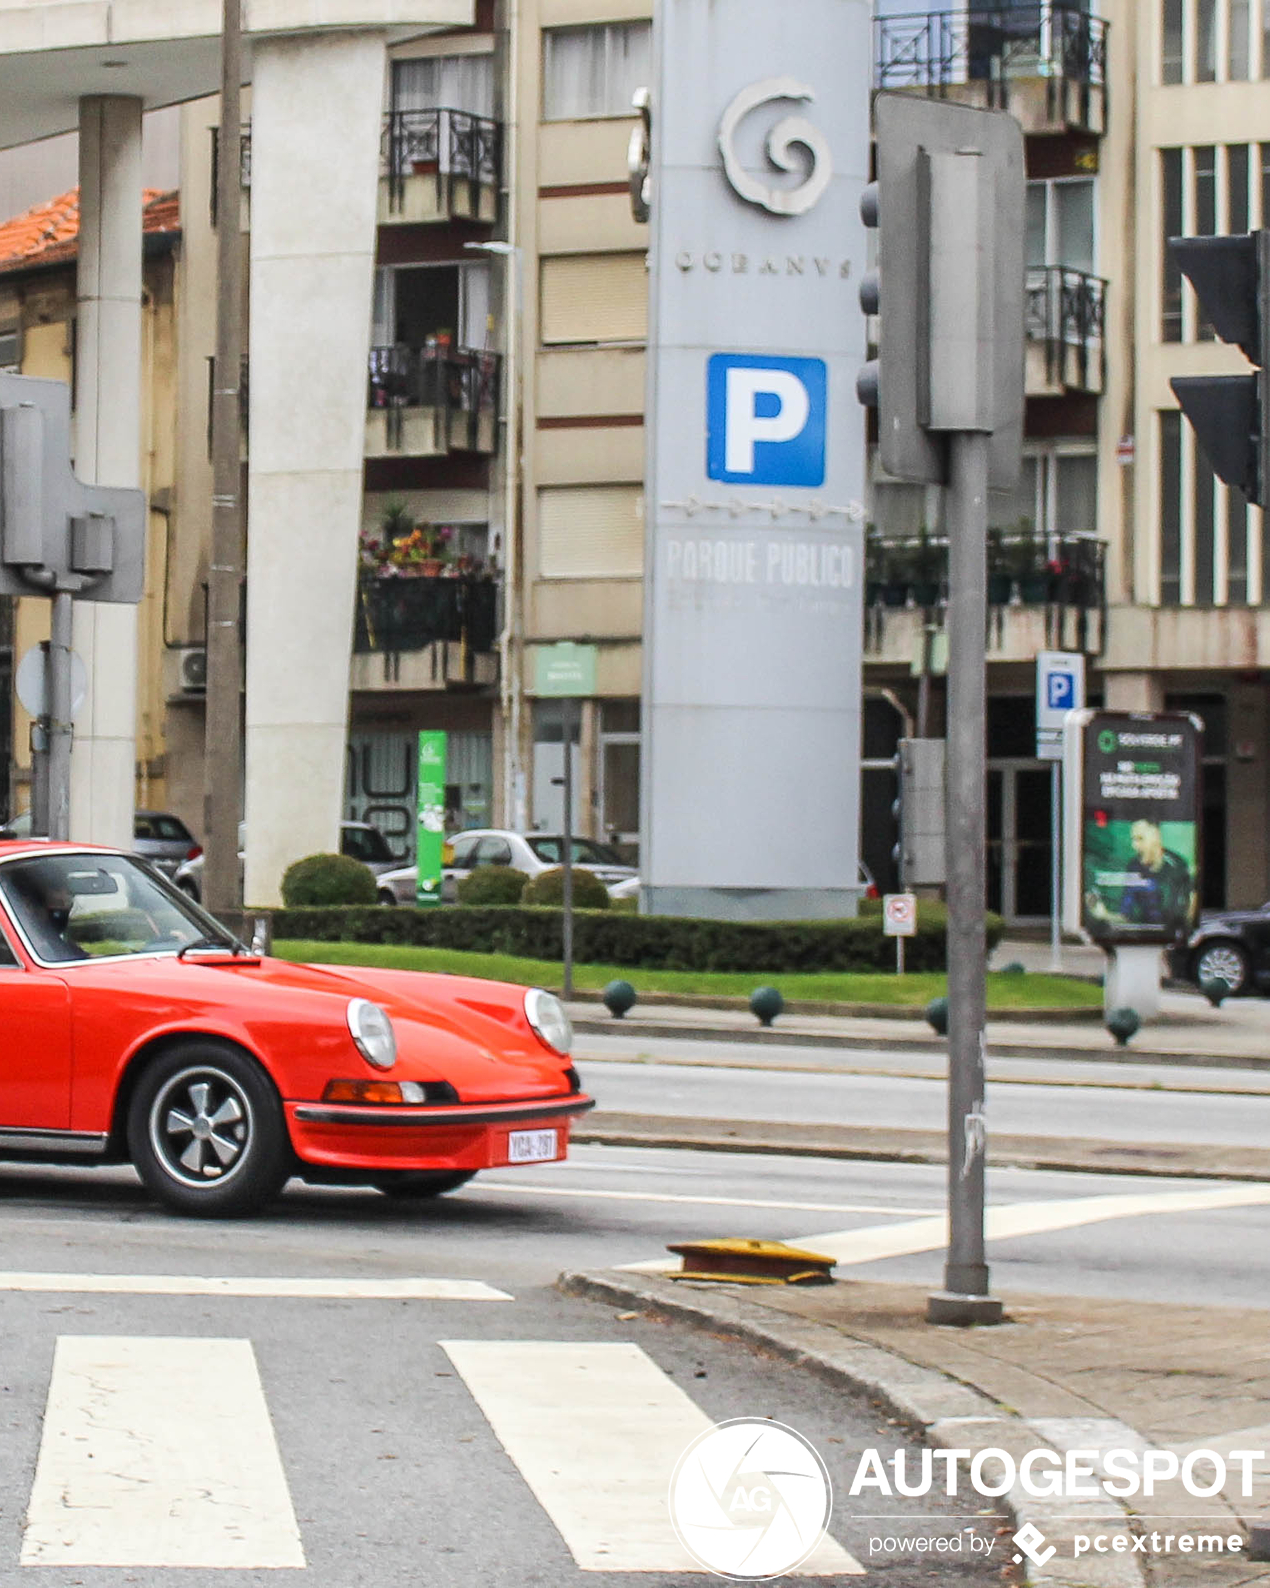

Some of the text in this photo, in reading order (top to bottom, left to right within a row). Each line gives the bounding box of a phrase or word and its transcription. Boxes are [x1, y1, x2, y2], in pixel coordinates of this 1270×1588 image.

[725, 367, 809, 473] P
[667, 540, 755, 583] PARQUE
[1050, 676, 1070, 706] P
